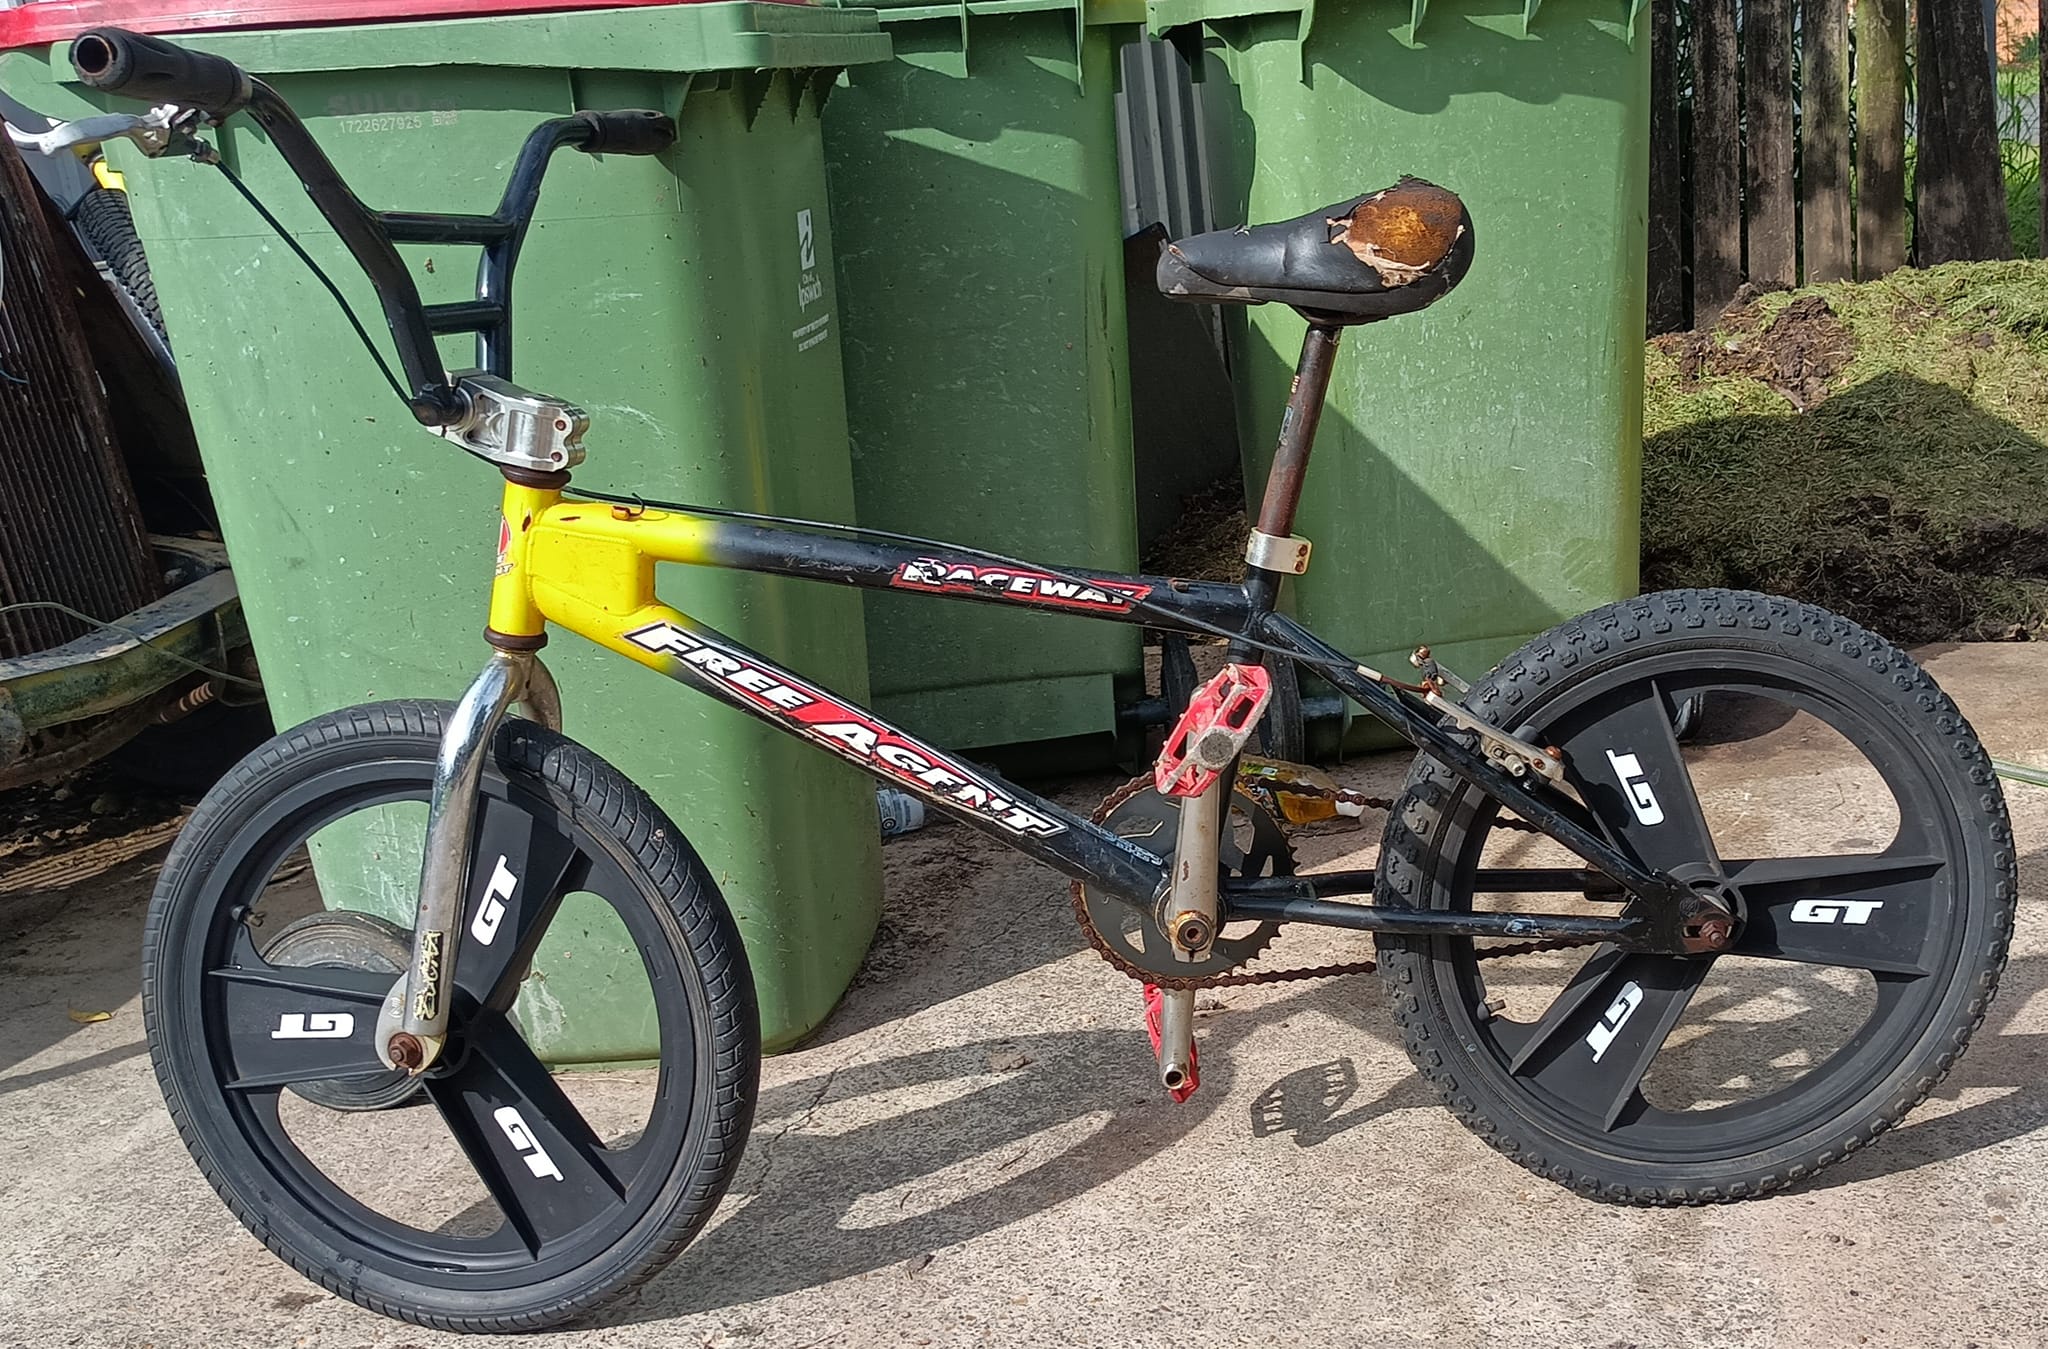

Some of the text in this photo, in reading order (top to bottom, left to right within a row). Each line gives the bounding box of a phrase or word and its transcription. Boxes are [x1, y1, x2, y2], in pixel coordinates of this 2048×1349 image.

[328, 89, 421, 115] SULO
[339, 116, 422, 134] 1722627925
[900, 557, 1137, 605] RACEWAY
[624, 622, 816, 711] FREE
[805, 721, 1068, 838] AGENT
[1605, 748, 1665, 826] GT
[471, 854, 518, 946] GT
[1790, 899, 1884, 925] GT
[271, 1012, 354, 1040] GT
[1586, 980, 1645, 1064] GT
[493, 1106, 564, 1182] GT
